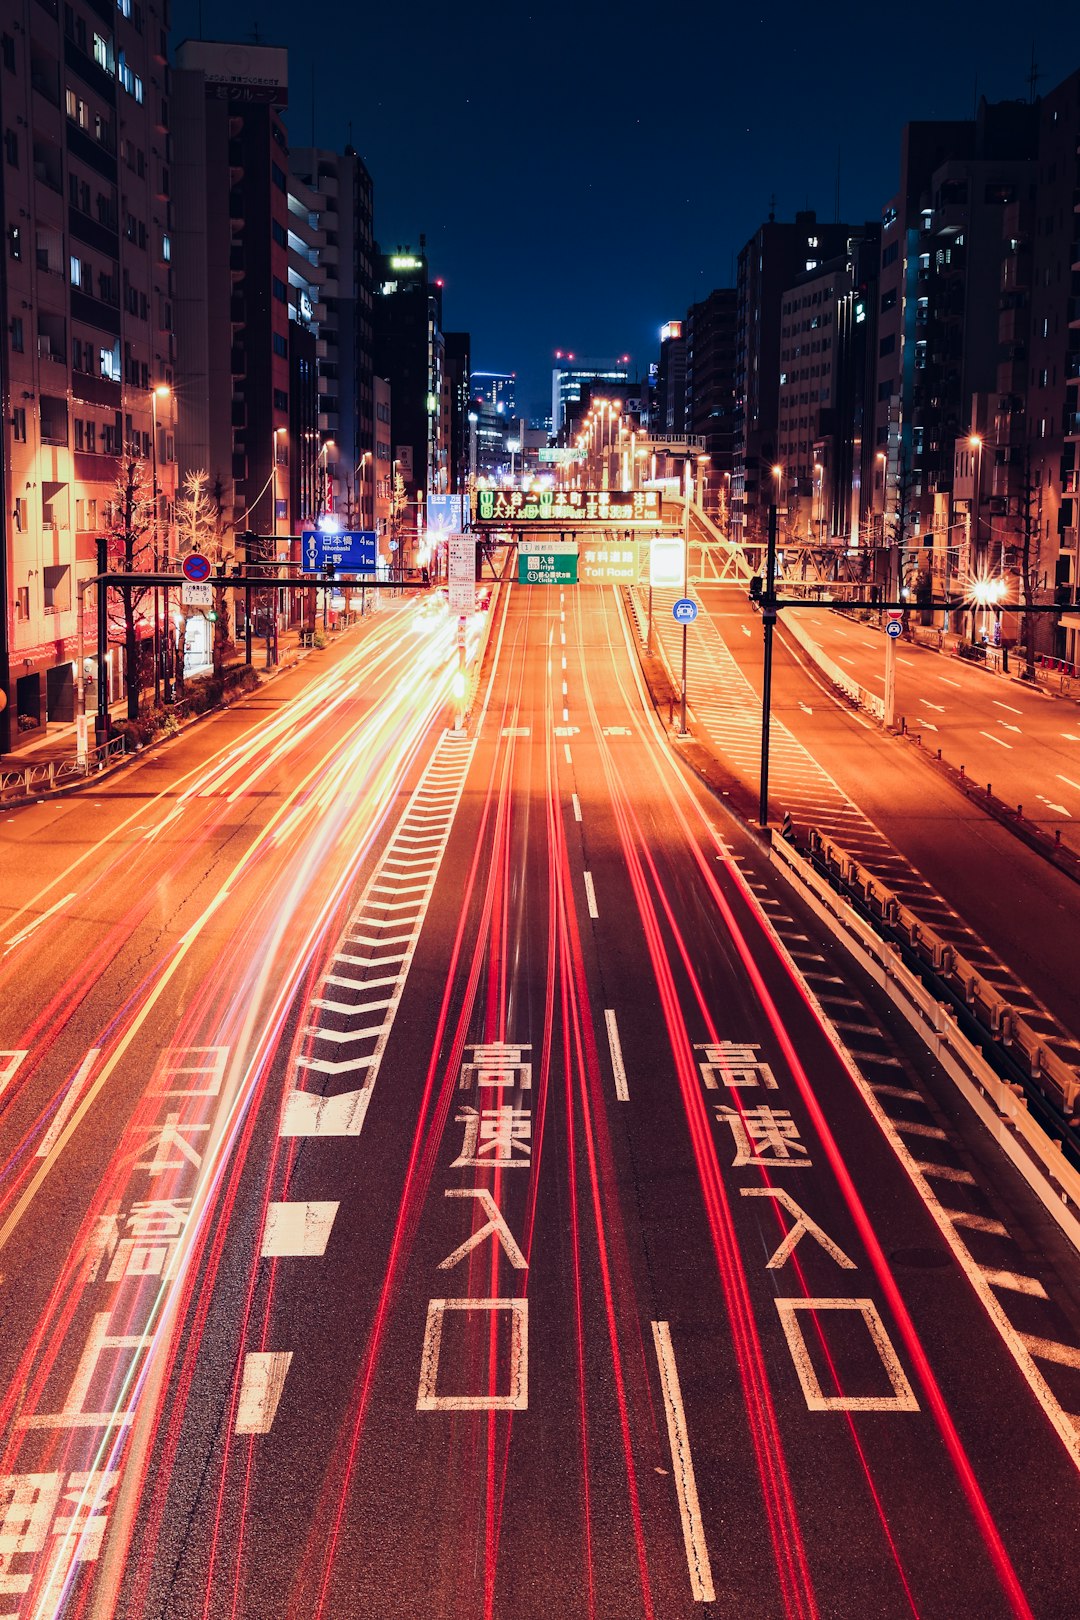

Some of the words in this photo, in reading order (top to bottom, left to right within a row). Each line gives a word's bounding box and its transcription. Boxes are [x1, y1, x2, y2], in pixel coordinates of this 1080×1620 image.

[496, 492, 522, 506] 入谷
[555, 492, 582, 506] 本町
[323, 535, 352, 546] 日本橋
[322, 554, 342, 564] 上野
[540, 556, 555, 564] 入谷
[584, 551, 634, 563] 有料道路
[584, 566, 604, 577] Toll
[606, 567, 634, 577] Road
